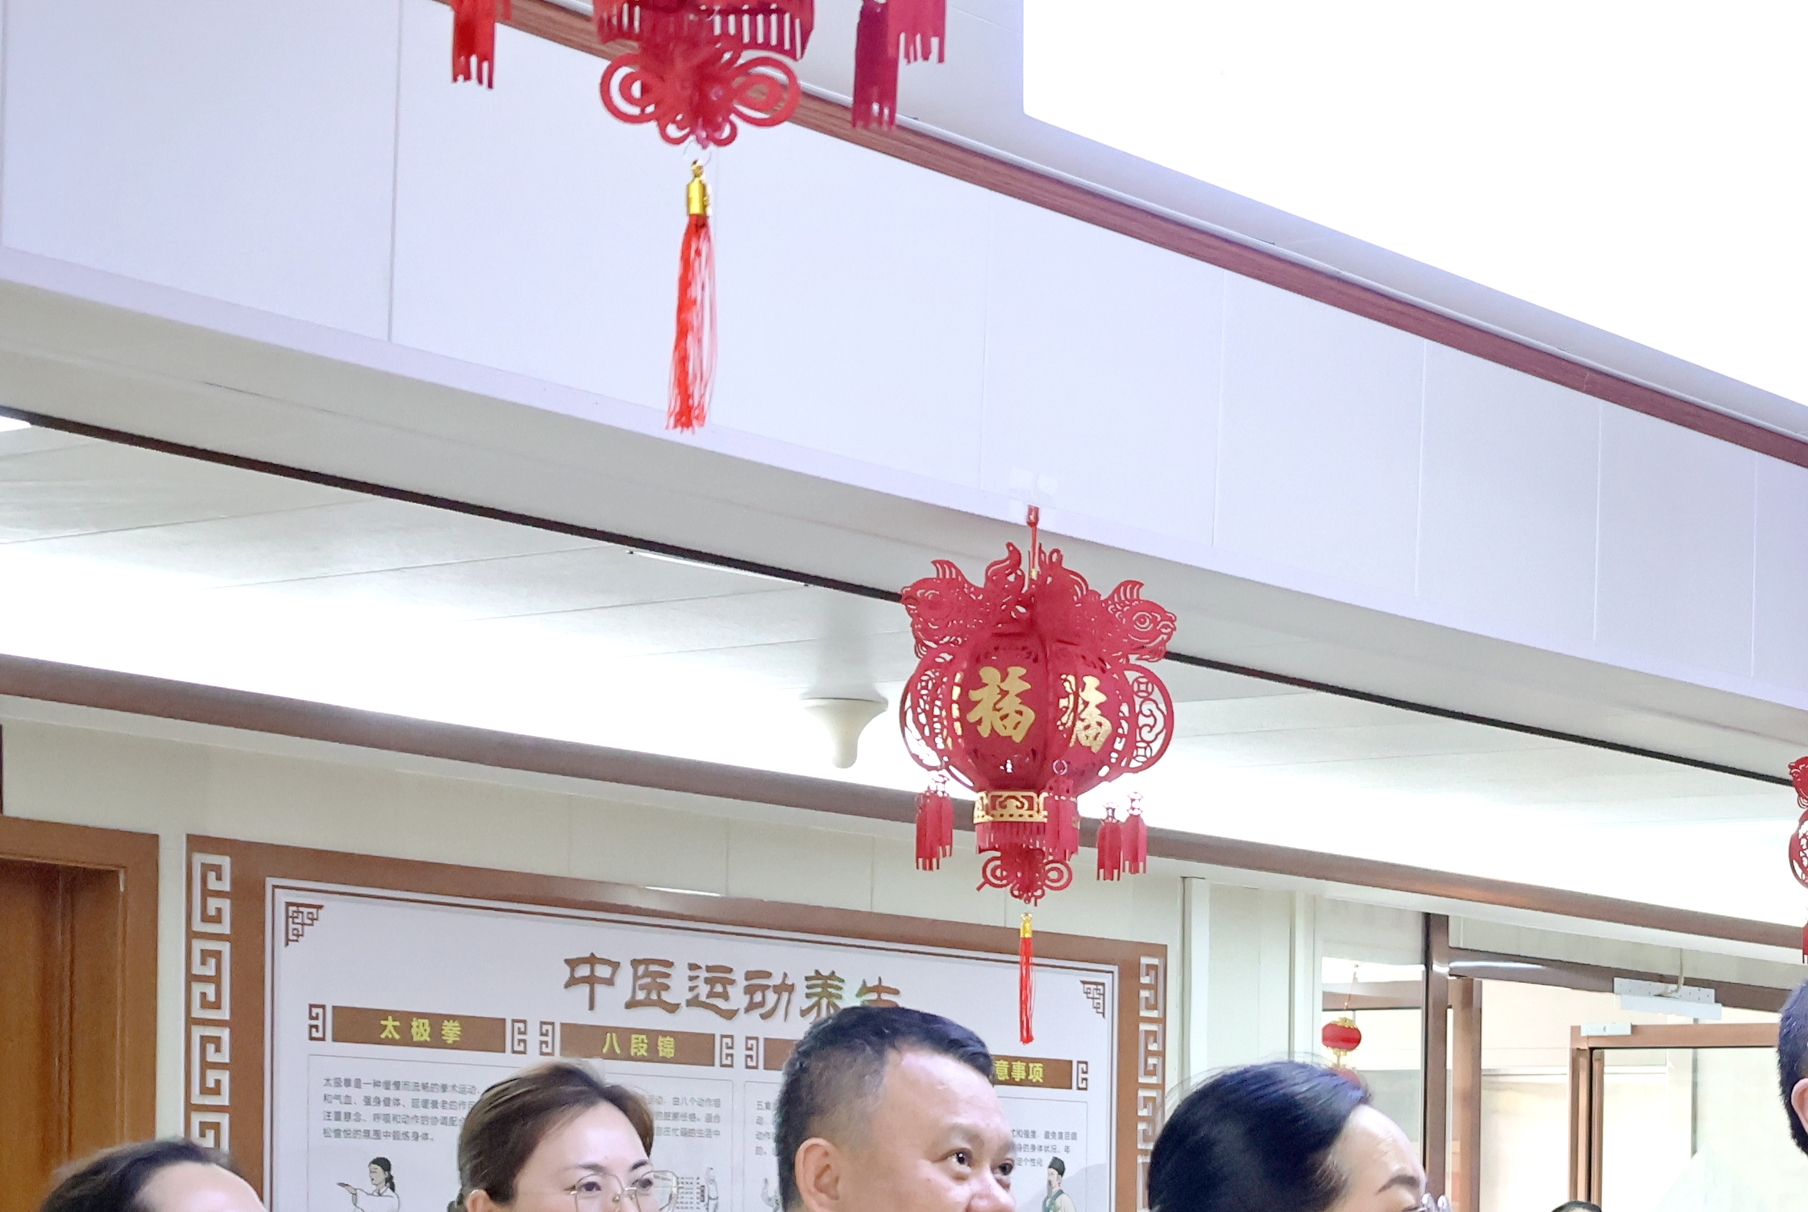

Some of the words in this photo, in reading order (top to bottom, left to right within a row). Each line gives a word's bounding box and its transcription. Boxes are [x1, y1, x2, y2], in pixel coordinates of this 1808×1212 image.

[966, 666, 1036, 742] 福
[379, 1016, 462, 1043] 太极拳
[601, 1032, 675, 1059] 八段锦
